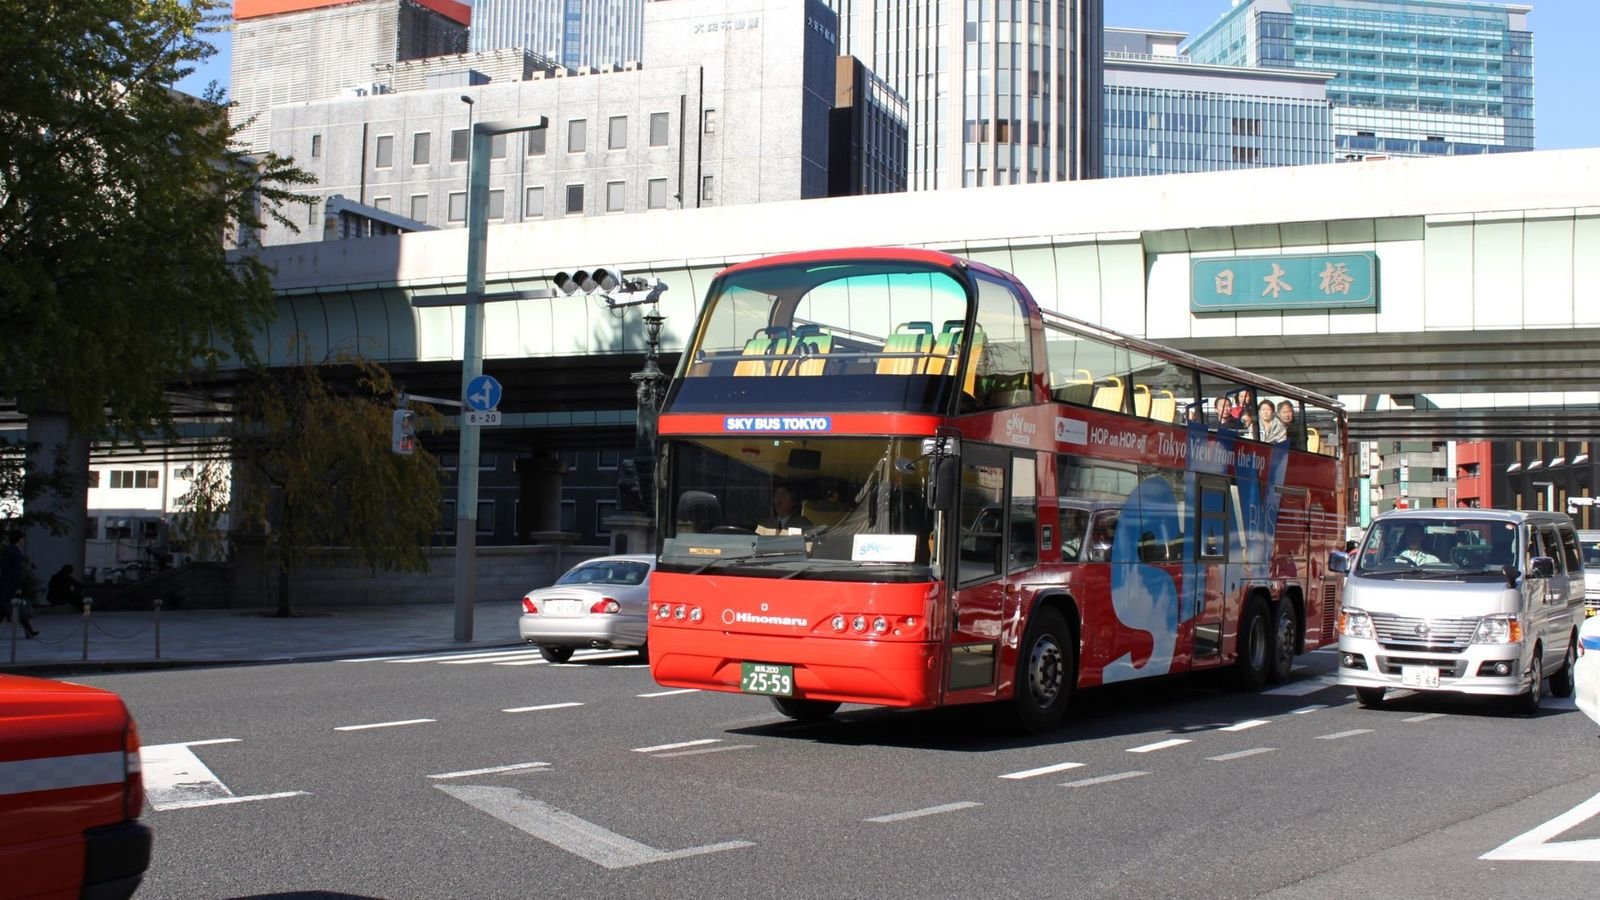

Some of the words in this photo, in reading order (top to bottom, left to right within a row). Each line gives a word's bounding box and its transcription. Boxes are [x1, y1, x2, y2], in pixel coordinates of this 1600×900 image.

[1214, 262, 1354, 299] 日本橋
[727, 417, 753, 430] SKY
[755, 417, 781, 430] BUS
[782, 417, 827, 430] TOKYO
[1090, 426, 1108, 444] HOP
[1109, 434, 1118, 446] on
[1119, 431, 1137, 449] HOP
[1137, 434, 1148, 454] off
[1157, 431, 1187, 464] Tokyo
[1189, 437, 1211, 462] View
[1214, 442, 1235, 466] from
[1237, 446, 1251, 468] the
[1252, 454, 1266, 477] top
[736, 612, 808, 626] Hinomaru
[749, 671, 791, 694] 25-59
